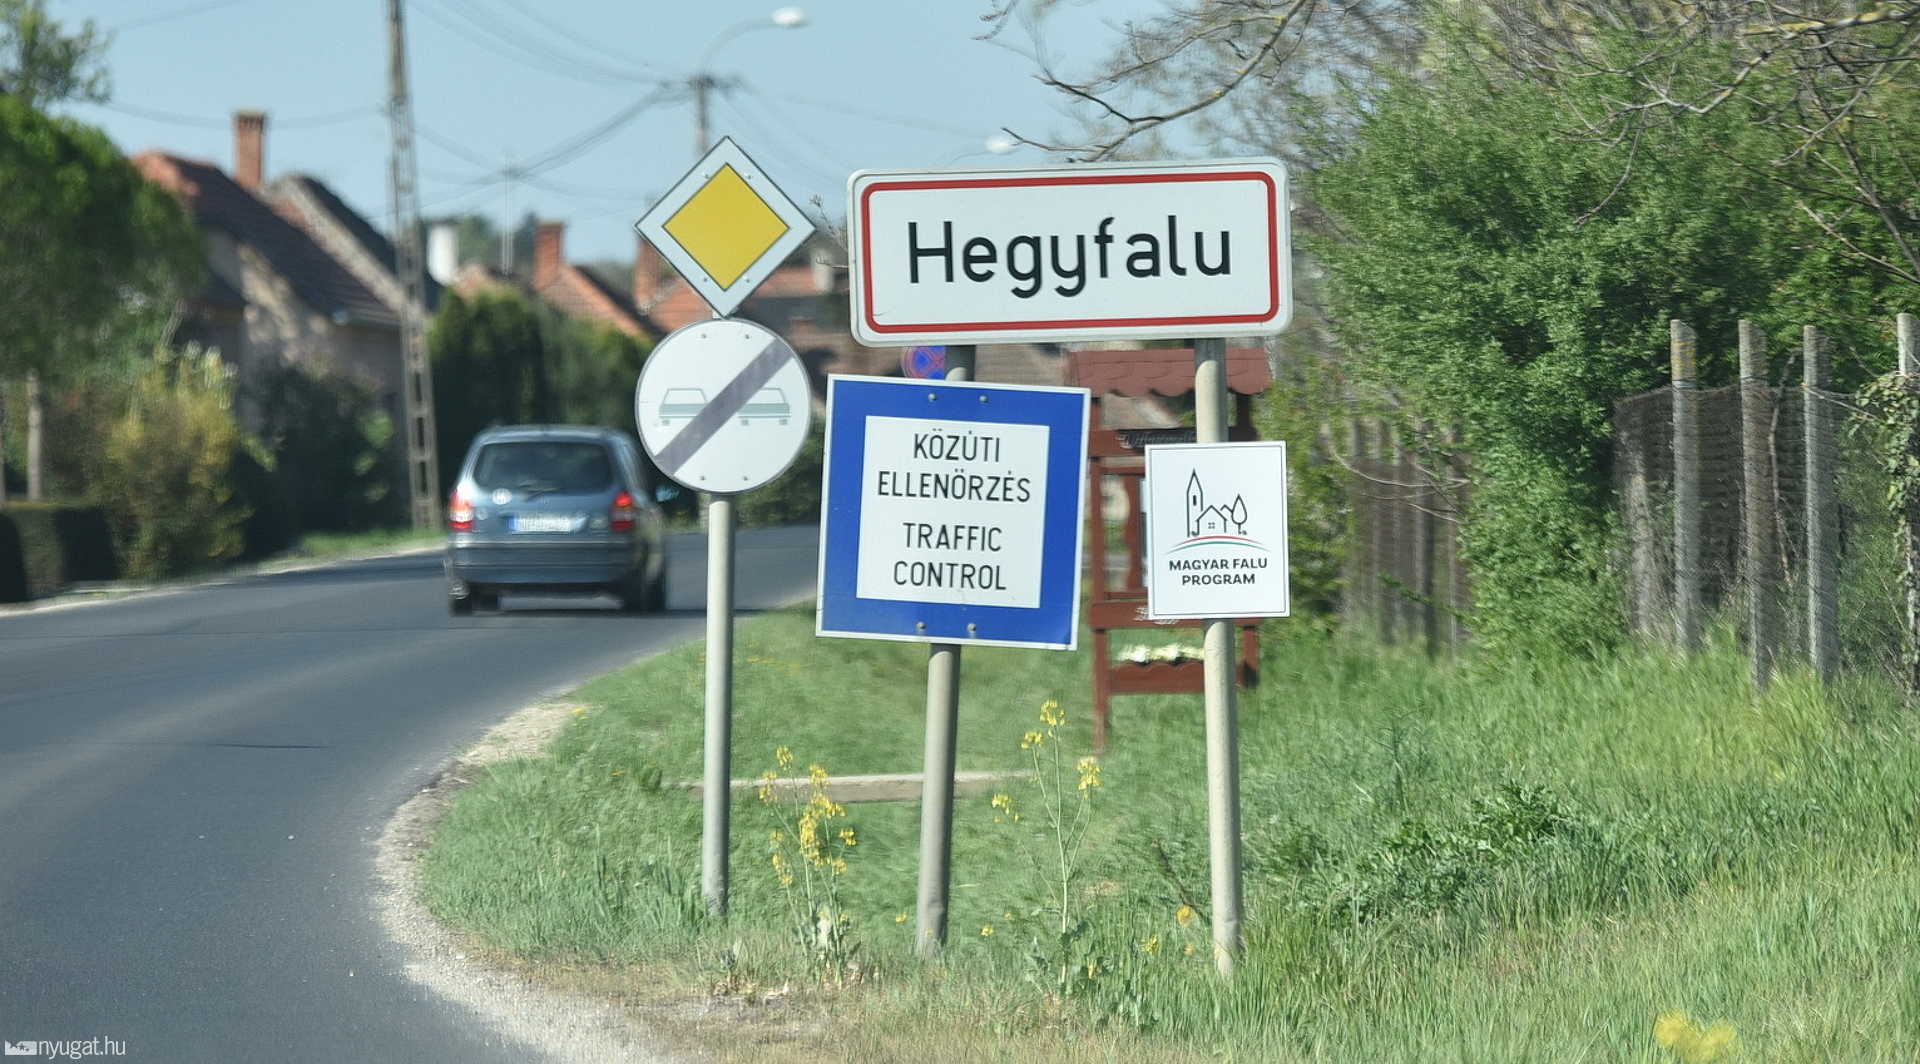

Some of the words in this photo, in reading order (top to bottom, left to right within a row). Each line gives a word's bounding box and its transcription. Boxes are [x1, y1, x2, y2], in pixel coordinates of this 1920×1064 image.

[908, 214, 1231, 298] Hegyfalu
[912, 427, 1001, 463] KÖZÚTI
[902, 522, 1003, 552] TRAFFIC
[893, 560, 1007, 590] CONTROL
[1168, 559, 1229, 571] MAGYAR
[1232, 557, 1268, 569] FALU
[1181, 573, 1256, 586] PROGRAM
